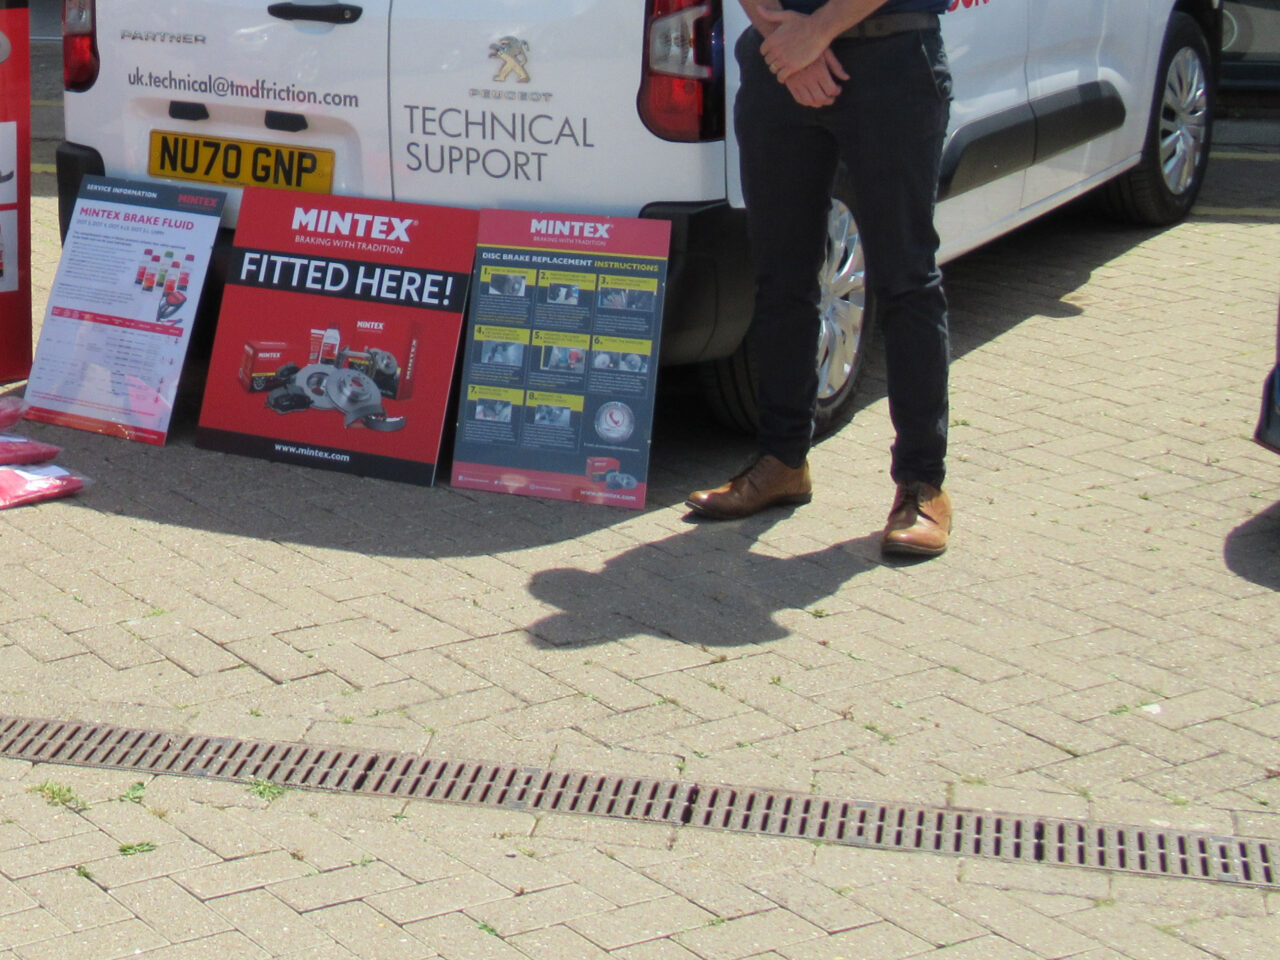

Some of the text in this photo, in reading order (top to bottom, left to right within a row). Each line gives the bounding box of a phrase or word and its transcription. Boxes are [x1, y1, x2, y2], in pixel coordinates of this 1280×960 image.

[120, 30, 207, 45] PARTNER
[128, 67, 359, 109] uk.technical@tmdfriction.com
[469, 88, 553, 102] PEUGEOT
[403, 105, 595, 148] TECHNICAL
[159, 136, 317, 188] NU70 GNP
[406, 141, 548, 182] SUPPORT
[86, 183, 158, 199] SERVICE INFORMATION
[178, 194, 219, 208] MINTEX
[80, 207, 195, 231] MINTEX BRAKE FLUID
[291, 207, 413, 242] MINTEX
[530, 219, 610, 239] MINTEX
[295, 235, 404, 255] BRAKING WITH TRADITION
[482, 252, 659, 272] DISC BRAKE REPLACEMENT INSTRUCTIONS
[239, 252, 454, 306] FITTED HERE!
[357, 321, 384, 330] MINTEX
[274, 443, 351, 463] www.mintex.com
